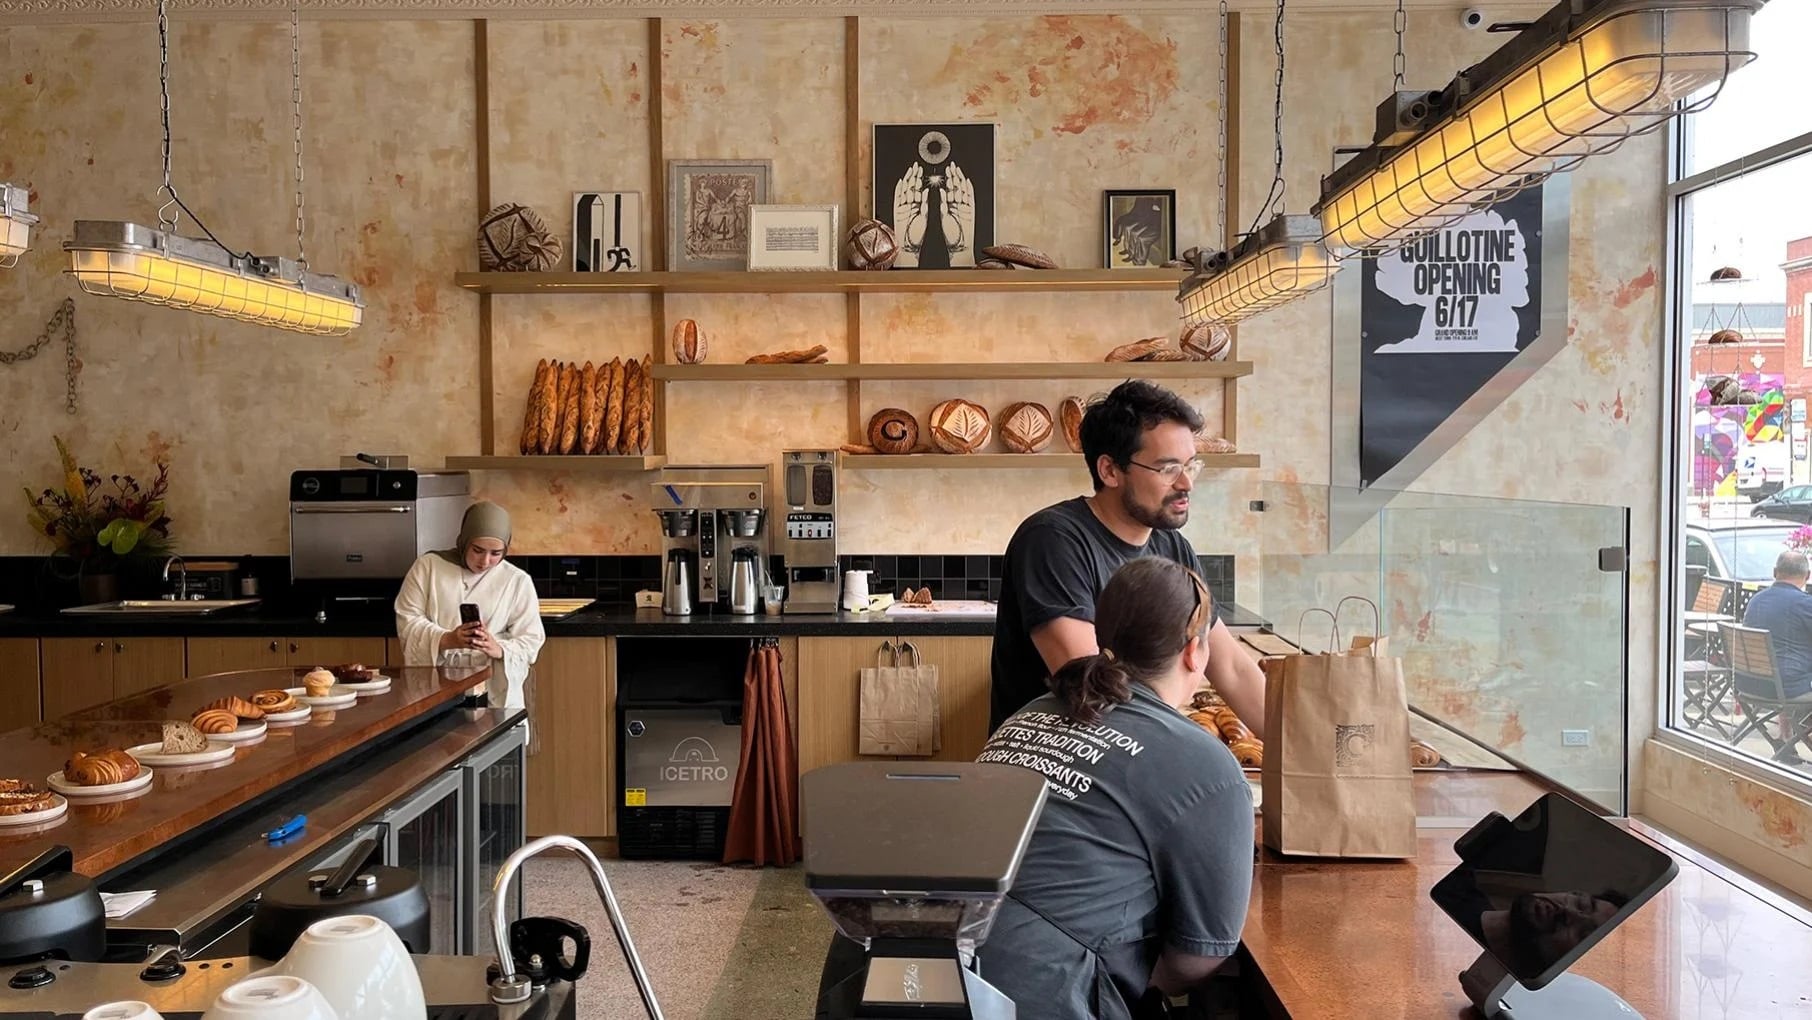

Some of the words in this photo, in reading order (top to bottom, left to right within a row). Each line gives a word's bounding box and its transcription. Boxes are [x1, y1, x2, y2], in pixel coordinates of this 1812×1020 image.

[717, 215, 730, 241] 4
[1400, 229, 1515, 263] GUILLOTINE
[1413, 262, 1501, 295] OPENING
[1435, 295, 1479, 328] 6/17
[1031, 711, 1060, 725] THE
[995, 726, 1036, 742] ETTES
[1032, 731, 1105, 765] TRADITION
[1039, 746, 1075, 764] sourdough
[660, 766, 729, 781] ICETRO
[1009, 752, 1092, 793] CROISSANTS
[1047, 780, 1079, 801] veryday
